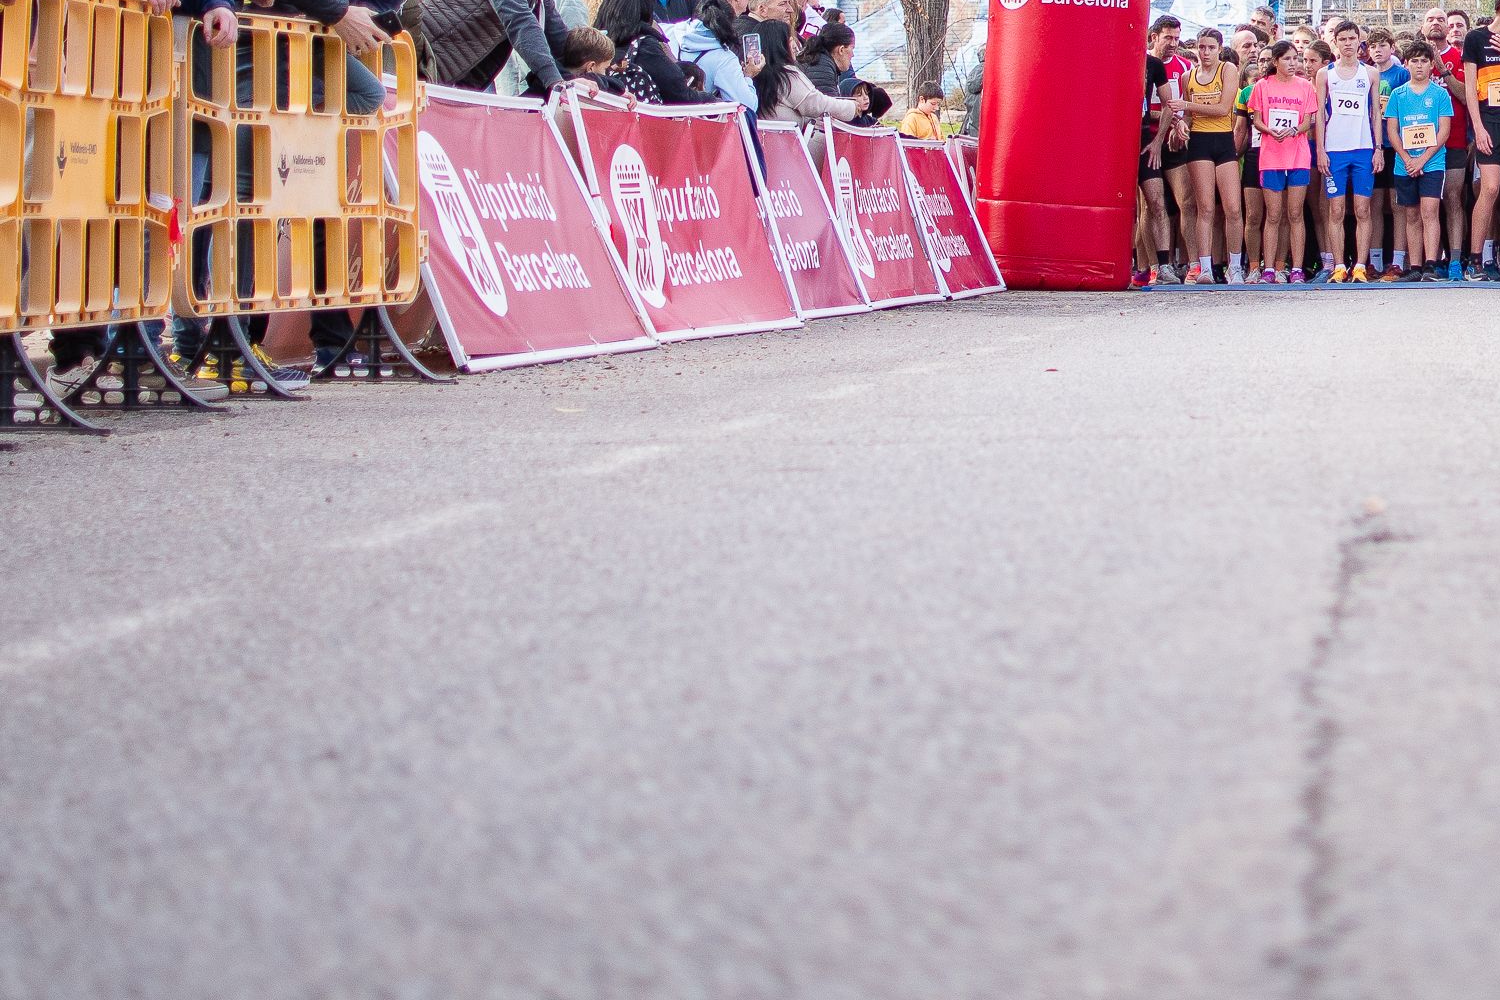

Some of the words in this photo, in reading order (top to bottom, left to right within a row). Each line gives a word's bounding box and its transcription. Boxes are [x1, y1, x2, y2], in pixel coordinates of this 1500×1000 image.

[1274, 118, 1292, 128] 721
[1338, 99, 1359, 109] 706
[463, 167, 557, 232] Diputació
[649, 174, 720, 232] Diputació
[855, 179, 900, 222] Diputació
[494, 240, 592, 292] Barcelona
[662, 239, 743, 287] Barcelona
[865, 227, 914, 262] Barcelona
